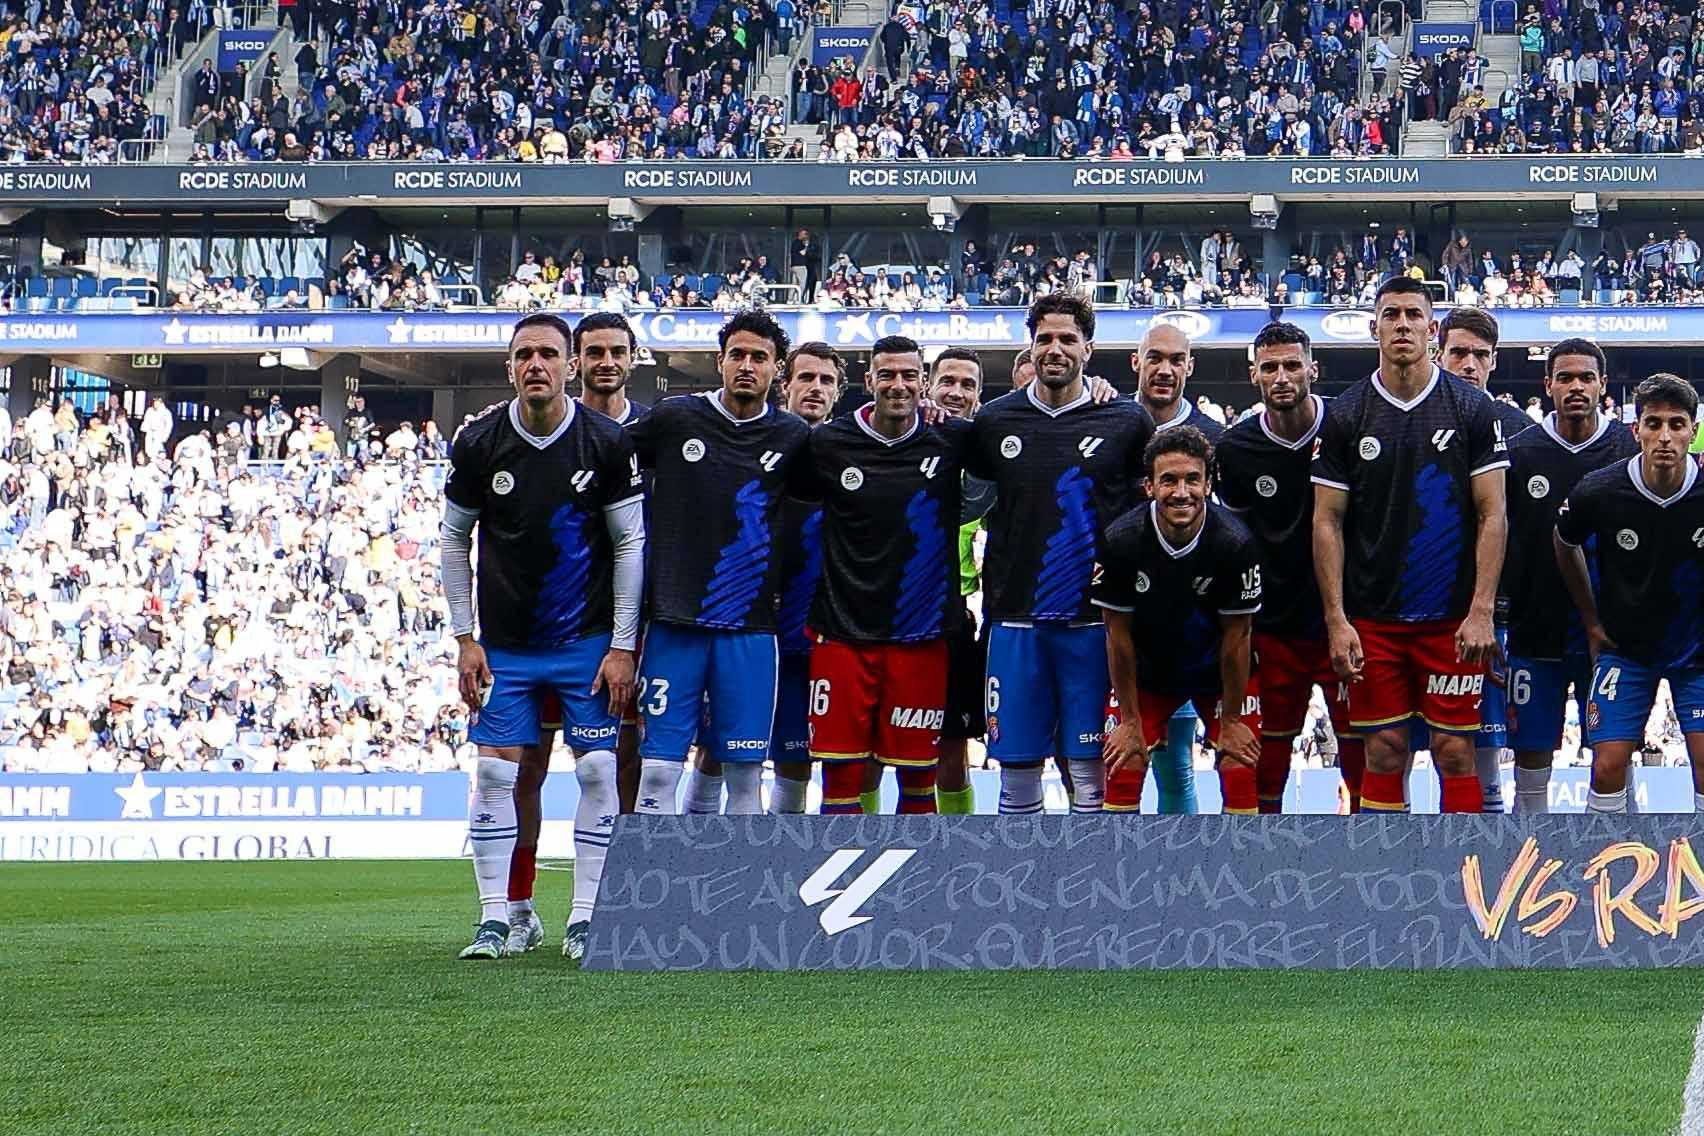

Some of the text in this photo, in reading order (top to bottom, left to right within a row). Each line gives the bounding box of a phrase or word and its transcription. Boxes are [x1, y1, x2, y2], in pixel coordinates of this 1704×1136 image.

[225, 40, 270, 51] SKOD
[819, 38, 870, 48] SKODA
[1419, 34, 1470, 44] SKODA
[17, 173, 91, 190] STADIUM
[179, 171, 308, 189] RCDE STADIUM
[394, 171, 523, 189] RCDE STADIUM
[624, 170, 753, 188] RCDE STADIUM
[848, 168, 977, 186] RCDE STADIUM
[1075, 167, 1204, 185] RCDE STADIUM
[1291, 166, 1420, 184] RCDE STADIUM
[1529, 165, 1658, 183] RCDE STADIUM
[9, 323, 78, 339] STADIUM
[875, 314, 1011, 340] CaixaBank
[1598, 316, 1667, 332] STADIUM
[1241, 564, 1261, 590] VS
[638, 676, 670, 716] 23
[808, 678, 831, 716] 16
[571, 725, 617, 739] SKODA
[163, 785, 424, 817] ESTRELLA DAMM
